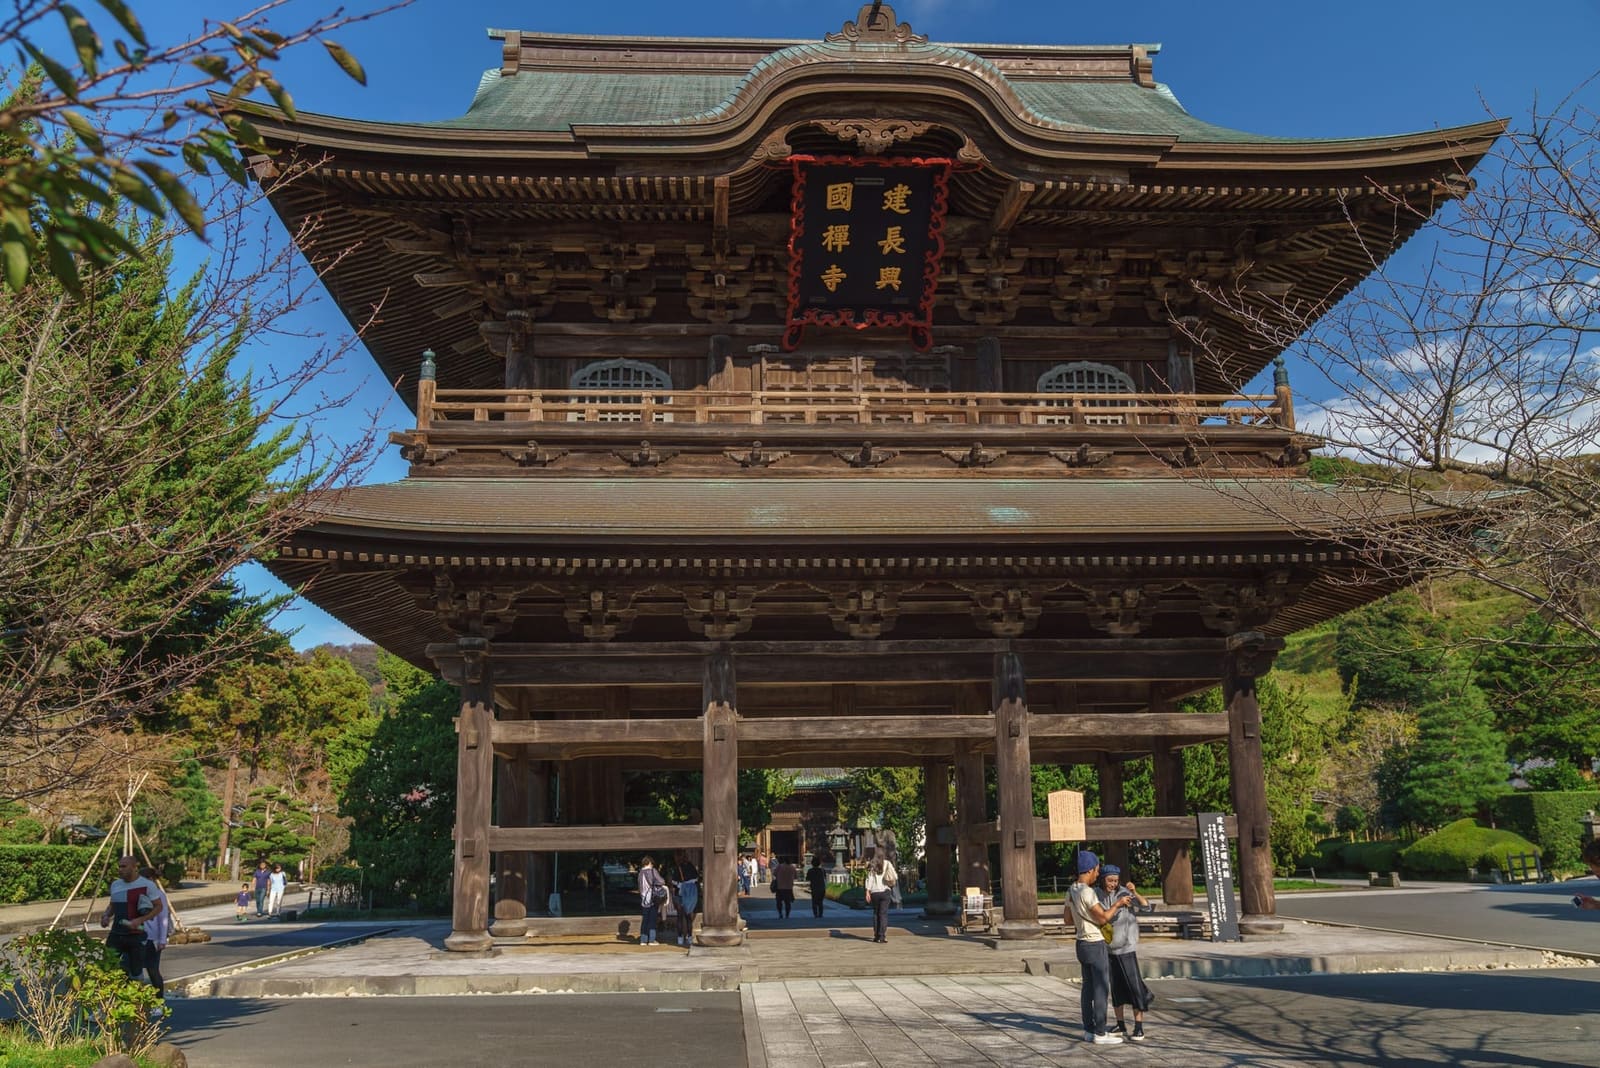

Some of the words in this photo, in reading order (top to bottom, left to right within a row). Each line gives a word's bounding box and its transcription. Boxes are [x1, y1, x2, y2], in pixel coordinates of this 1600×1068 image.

[820, 182, 854, 292] 國禪寺
[875, 183, 912, 291] 建長興
